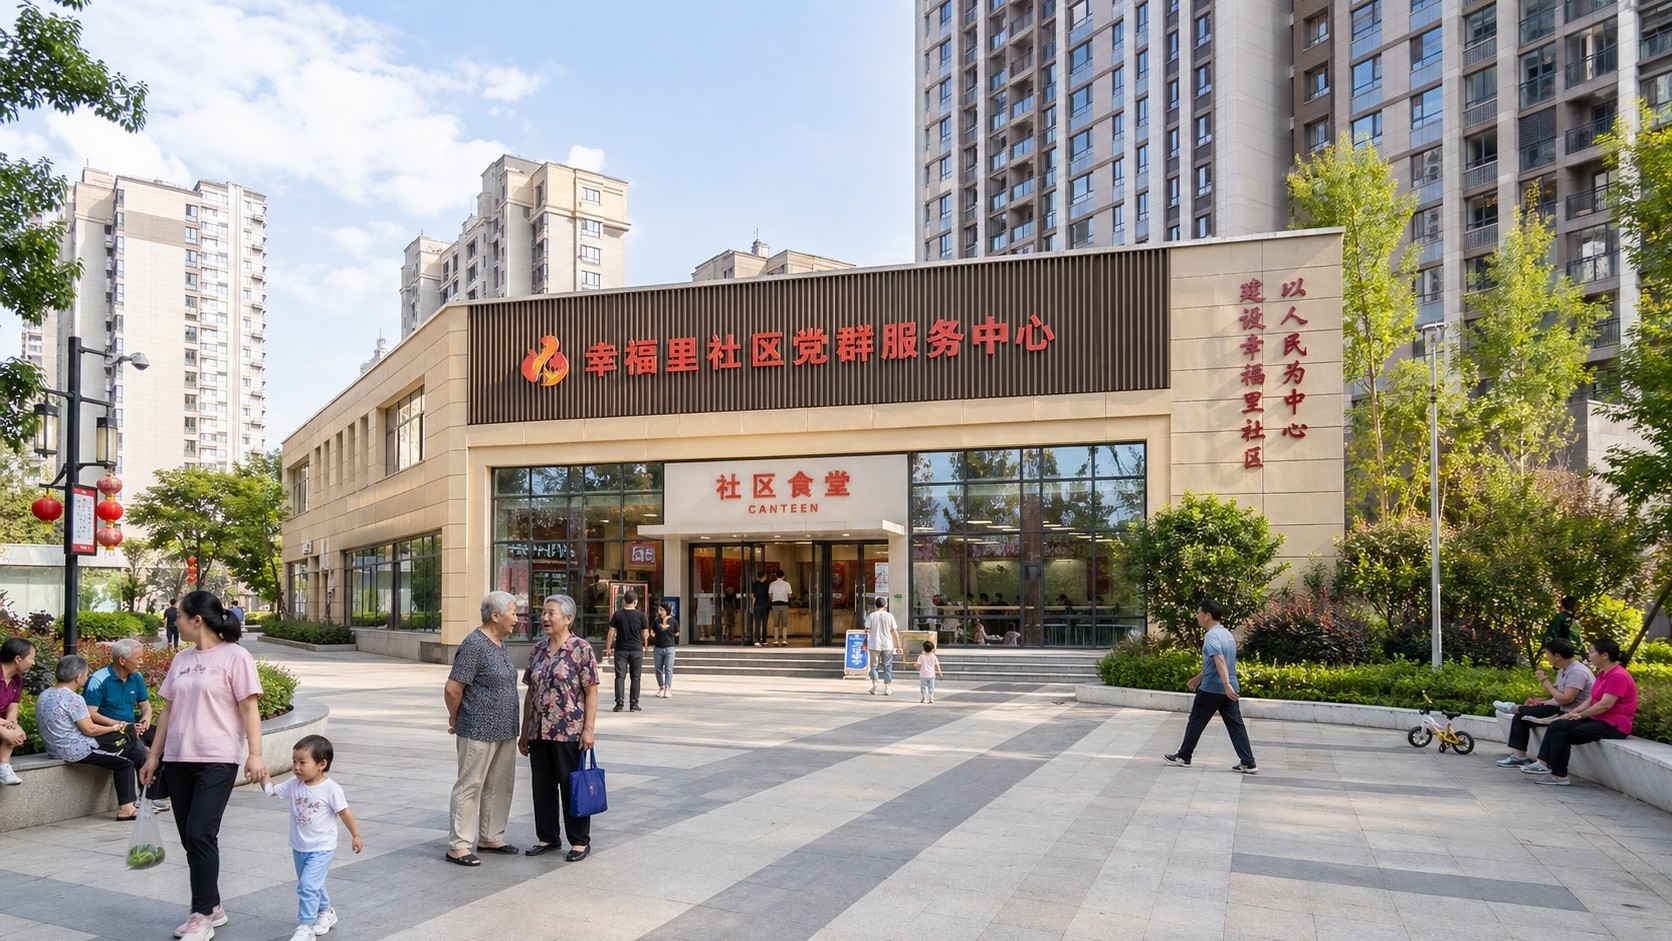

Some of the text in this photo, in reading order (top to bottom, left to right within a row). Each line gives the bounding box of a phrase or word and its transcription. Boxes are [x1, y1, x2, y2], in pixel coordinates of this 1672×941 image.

[585, 314, 1056, 378] 幸福里社区党群服务中心
[1239, 277, 1266, 469] 建设幸福里社区
[1281, 277, 1308, 439] 以人民为中心
[716, 470, 850, 500] 社区食堂
[748, 503, 818, 514] CANTEEN
